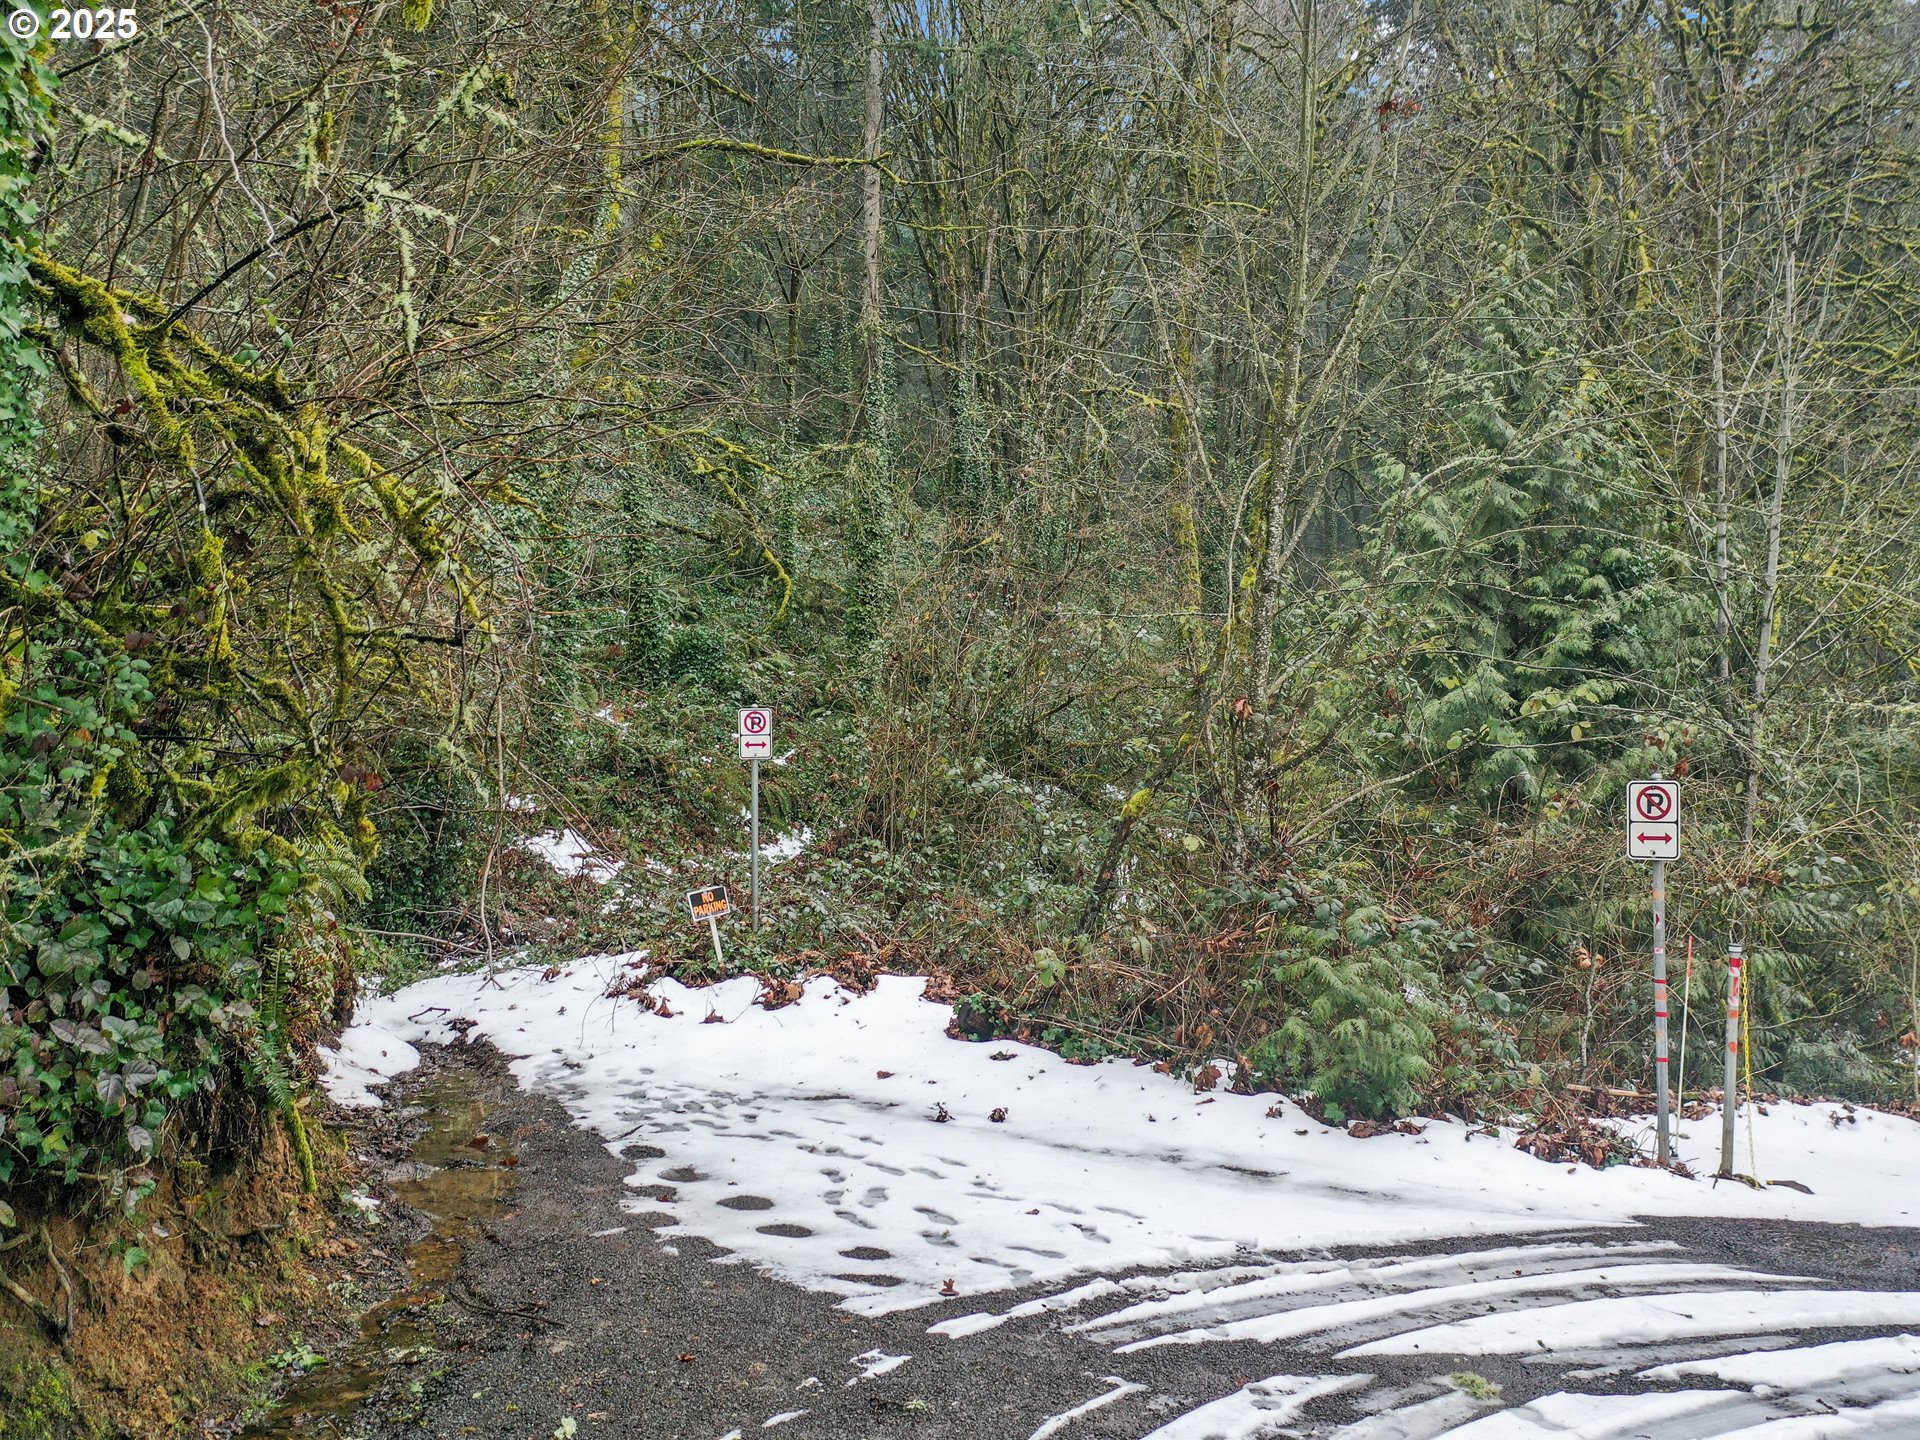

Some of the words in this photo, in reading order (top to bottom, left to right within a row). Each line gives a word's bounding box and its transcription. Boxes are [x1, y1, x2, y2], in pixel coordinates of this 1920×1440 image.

[750, 716, 762, 730] P
[1646, 793, 1664, 814] P
[701, 891, 714, 903] NO
[693, 899, 728, 917] PARKING
